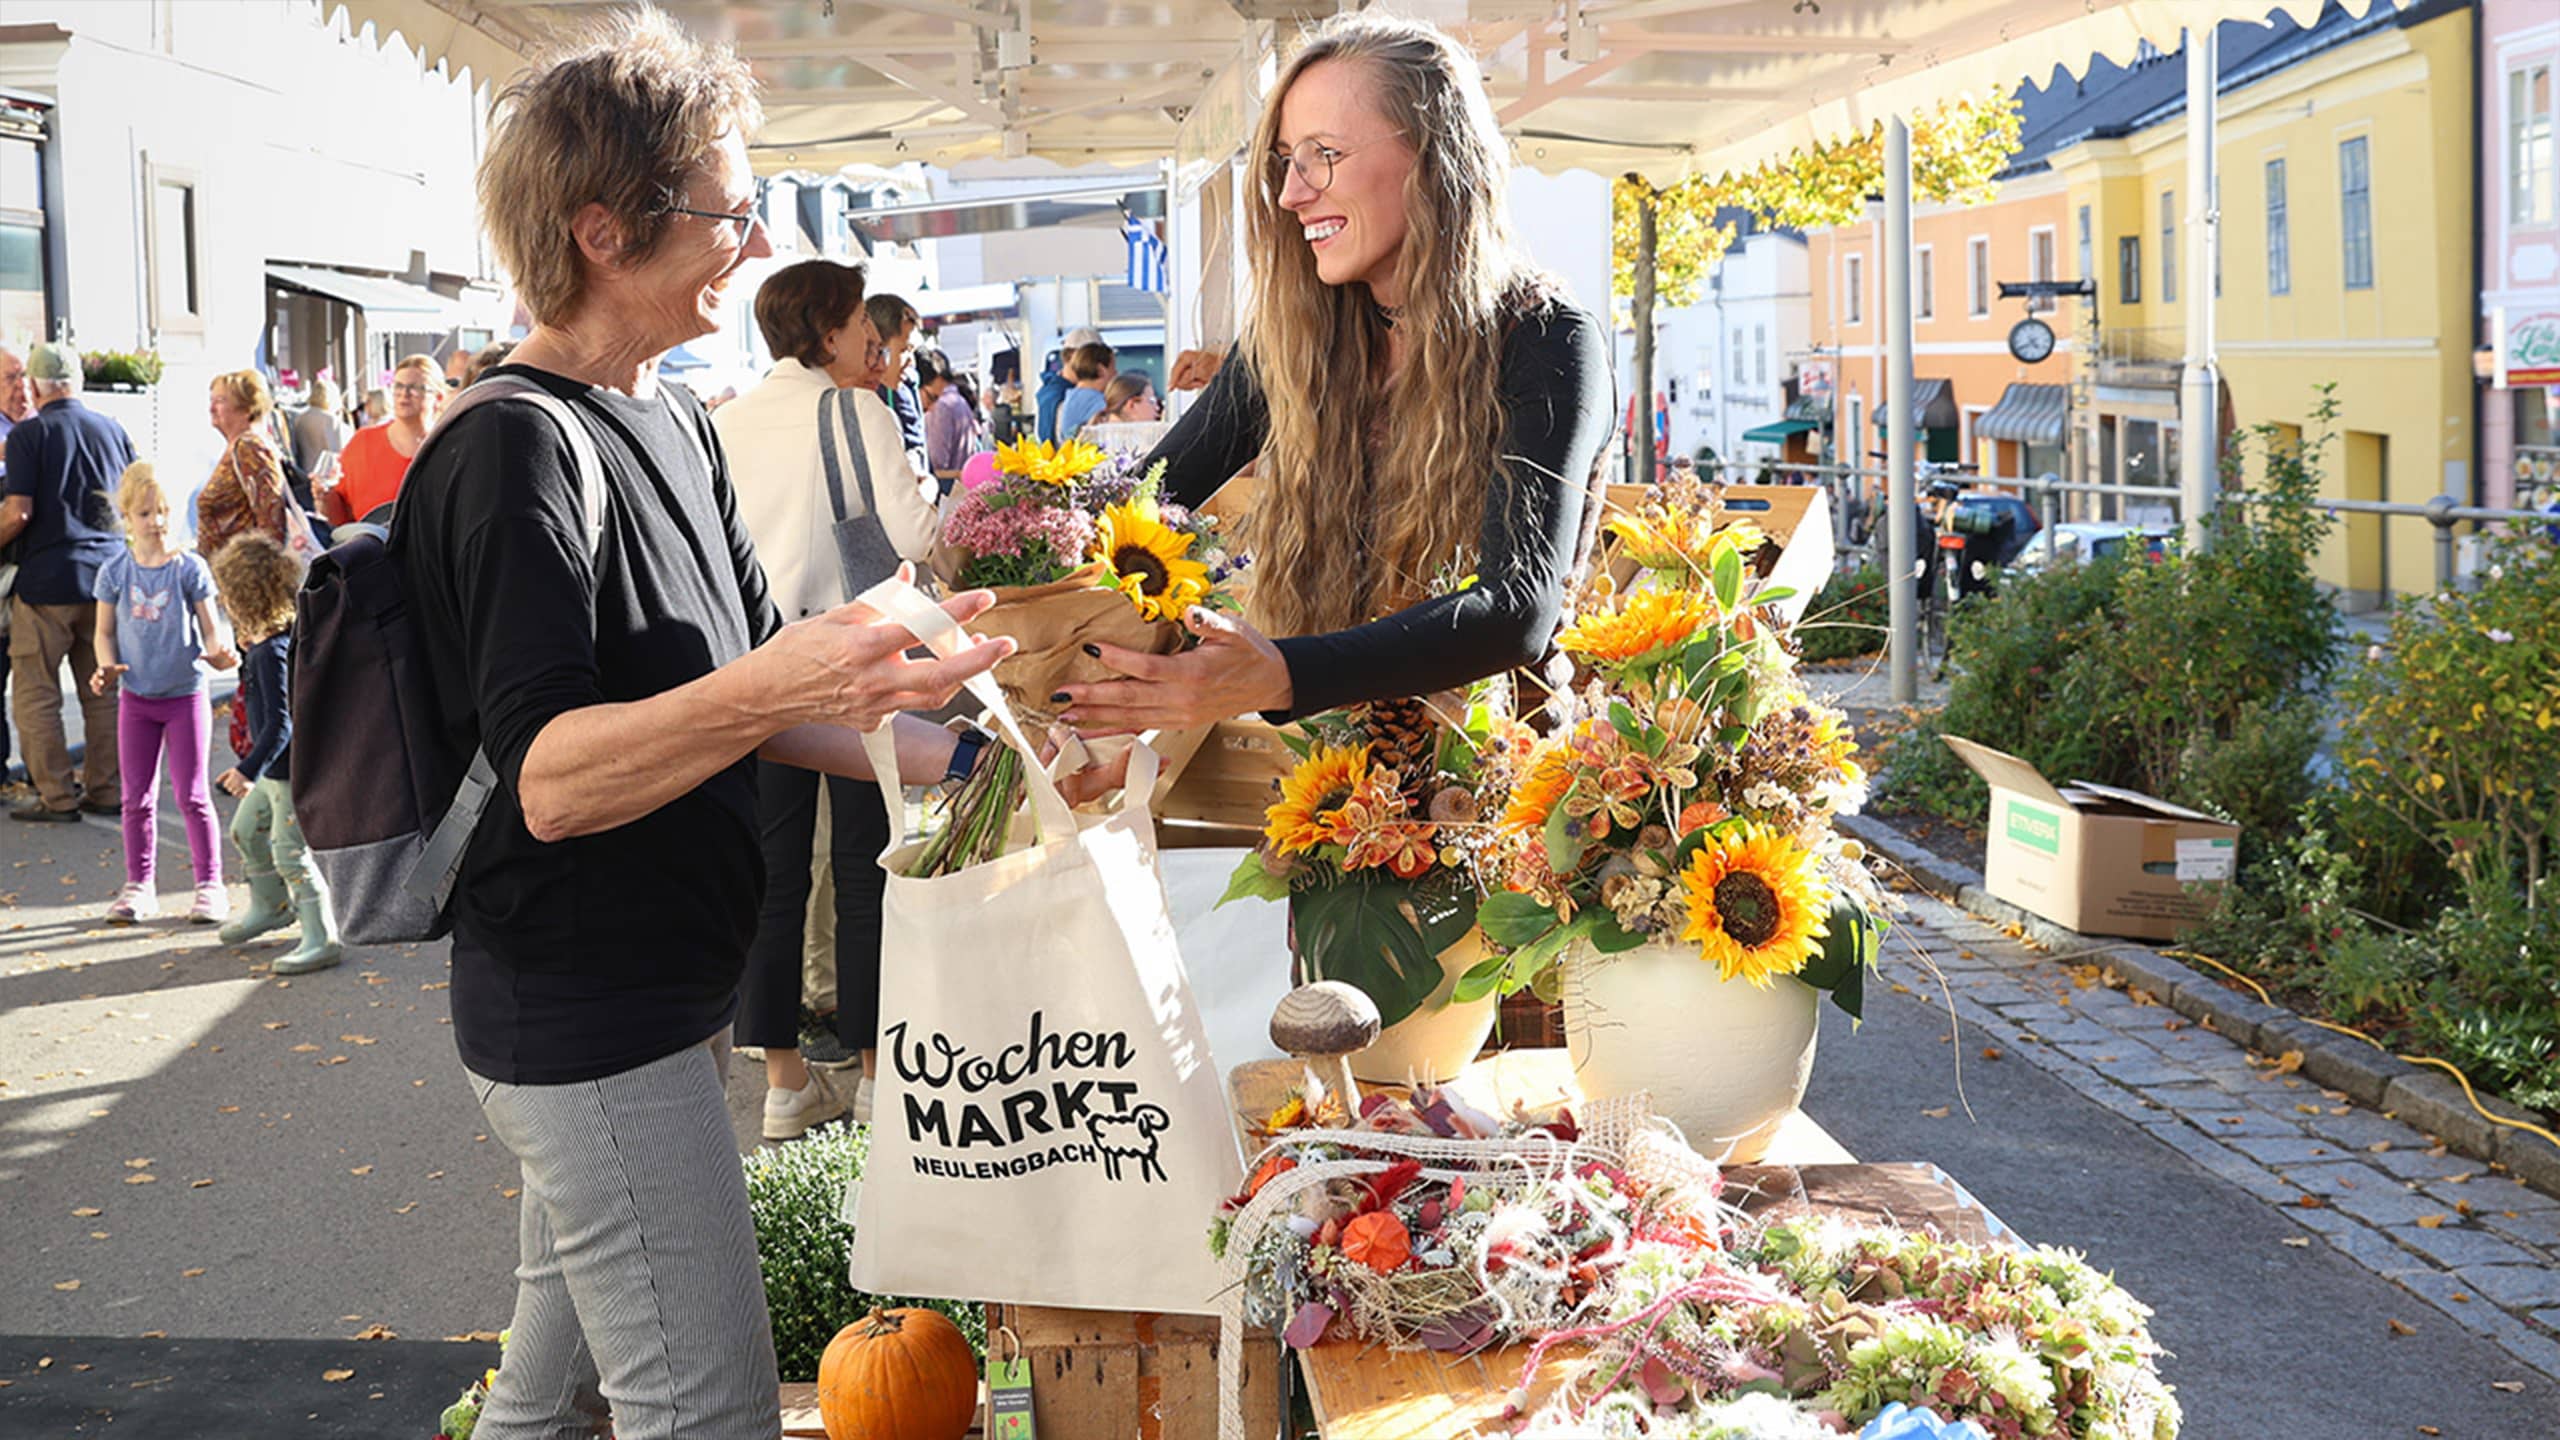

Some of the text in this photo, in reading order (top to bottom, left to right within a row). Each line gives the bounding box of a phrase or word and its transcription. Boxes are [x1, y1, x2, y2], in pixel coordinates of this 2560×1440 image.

[885, 1010, 1135, 1093] Wochen
[903, 1080, 1137, 1148] MARKT
[912, 1143, 1097, 1180] NEULENGBACH
